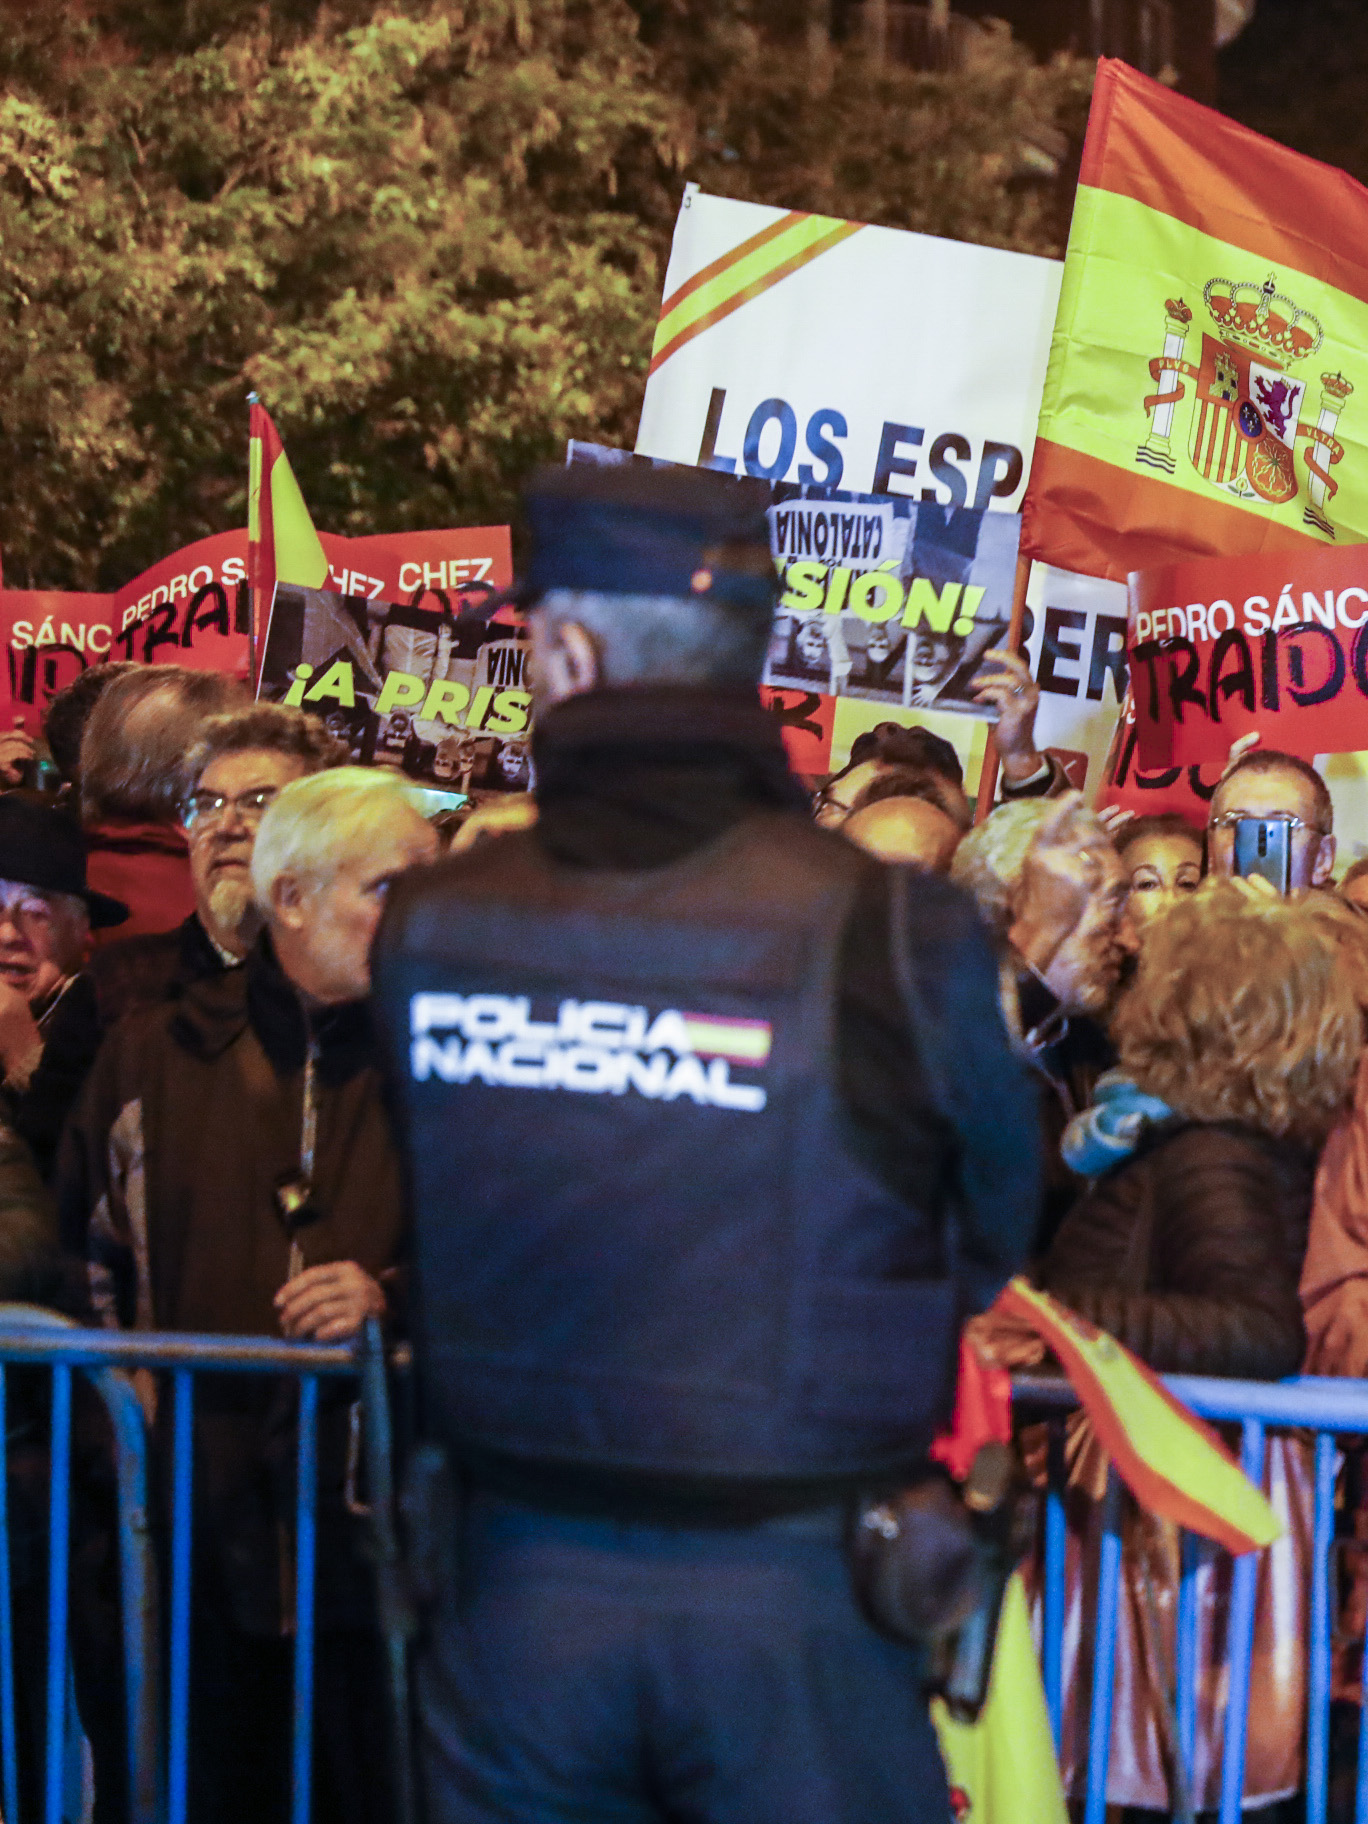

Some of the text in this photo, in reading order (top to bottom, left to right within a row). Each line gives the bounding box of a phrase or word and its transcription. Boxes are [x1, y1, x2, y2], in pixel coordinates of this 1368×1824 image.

[697, 386, 1023, 511] LOS ESP
[776, 511, 883, 559] CATALONIA
[122, 565, 213, 631] PEDRO
[398, 557, 494, 592] CHEZ
[11, 614, 113, 653] SÁNC
[116, 578, 249, 663] TRAI
[1136, 599, 1236, 645] PEDRO
[374, 670, 534, 734] PRIS
[409, 992, 696, 1056] POLICIA
[410, 1036, 768, 1113] NACIONAL
